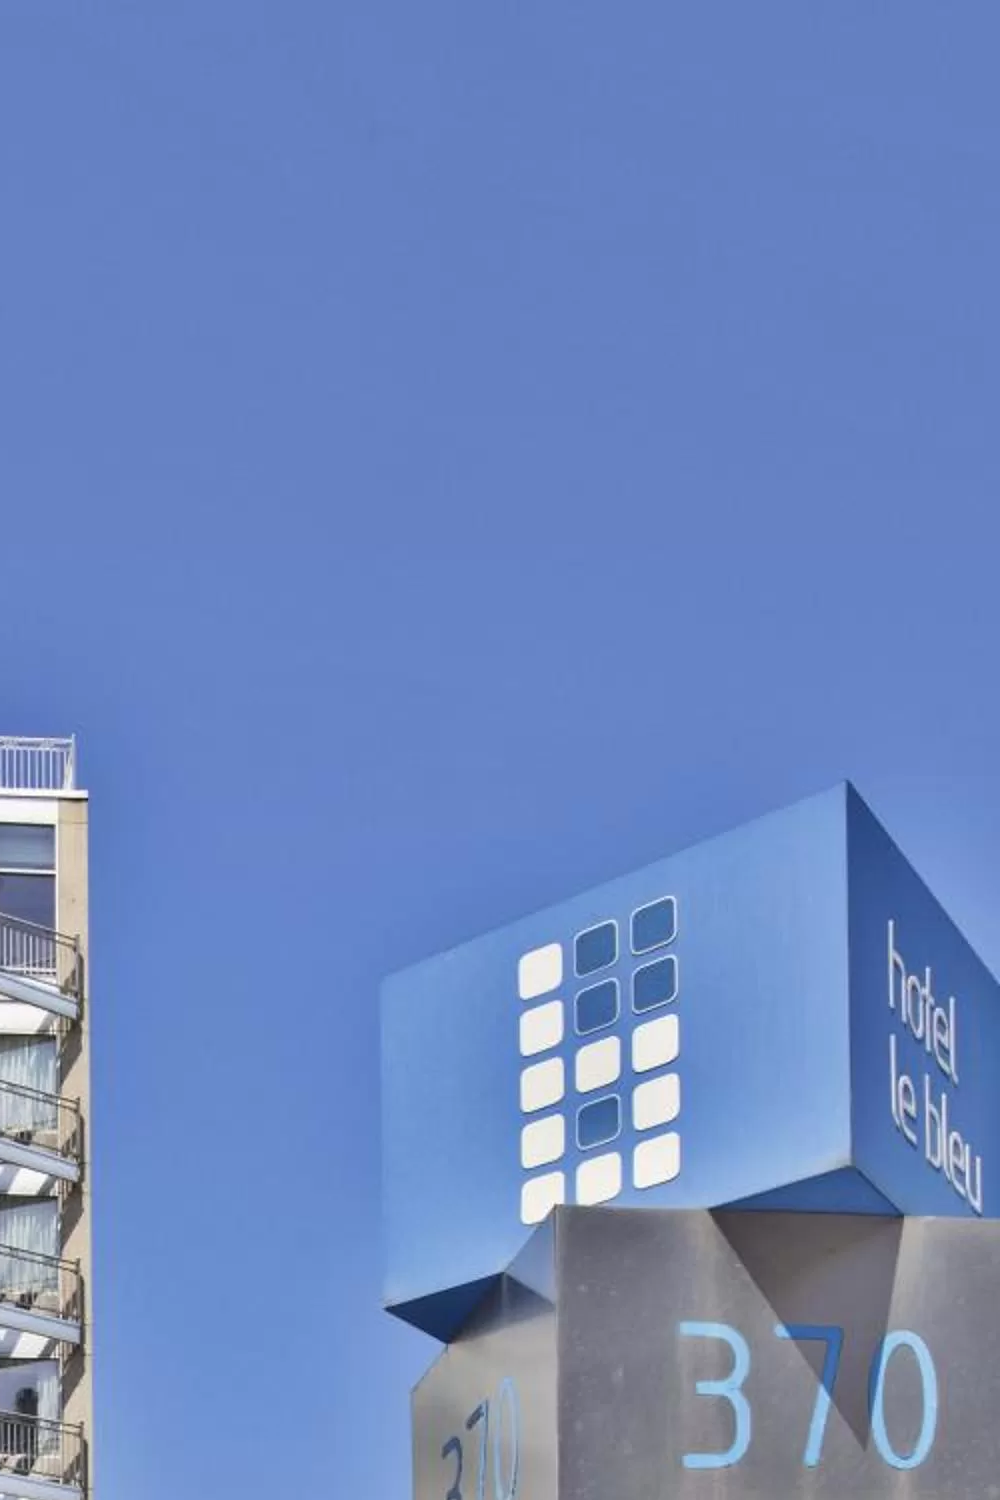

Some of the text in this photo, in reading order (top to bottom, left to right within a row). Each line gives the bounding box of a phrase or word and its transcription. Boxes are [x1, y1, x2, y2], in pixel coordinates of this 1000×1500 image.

[887, 918, 959, 1085] hotel
[889, 1033, 983, 1218] le bleu
[677, 1320, 938, 1471] 370
